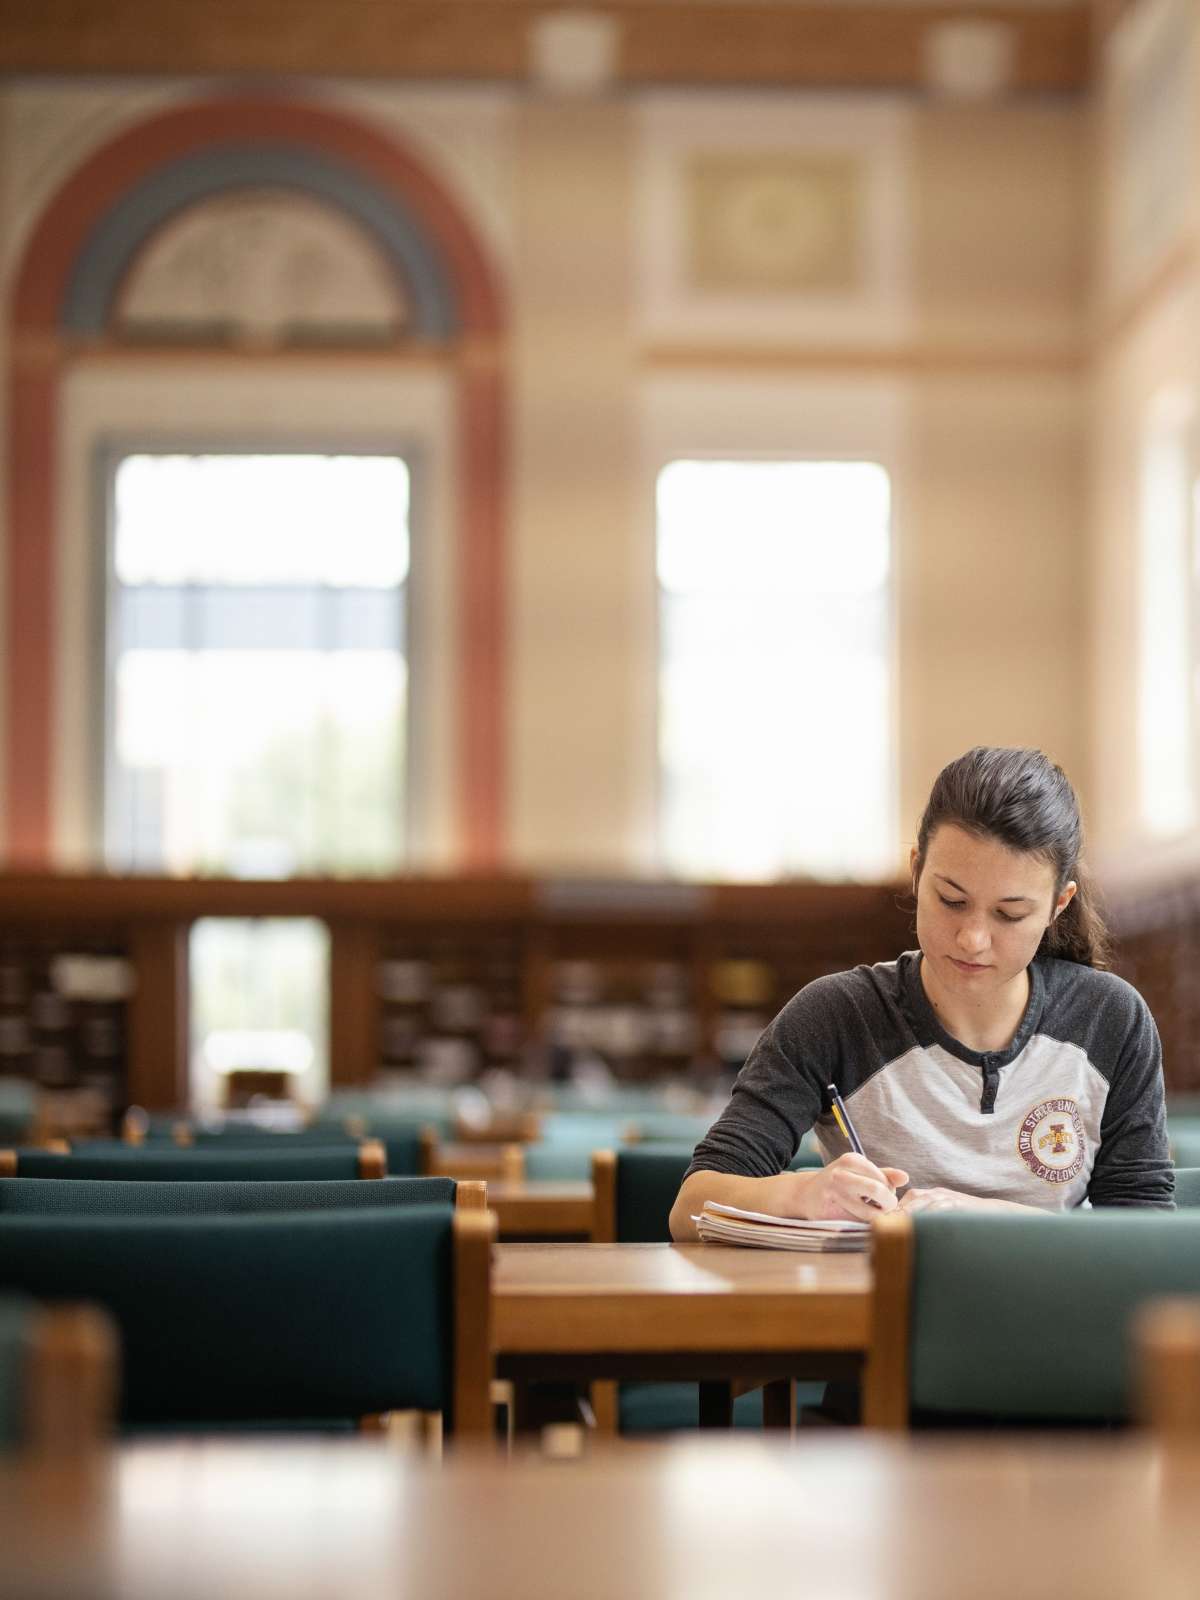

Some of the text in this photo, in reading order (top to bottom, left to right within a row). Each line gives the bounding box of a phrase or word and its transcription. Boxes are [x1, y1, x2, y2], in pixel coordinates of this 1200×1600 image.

[1025, 1102, 1054, 1128] STATE
[1020, 1130, 1032, 1154] IOWA
[1037, 1158, 1083, 1182] CYCLONES
